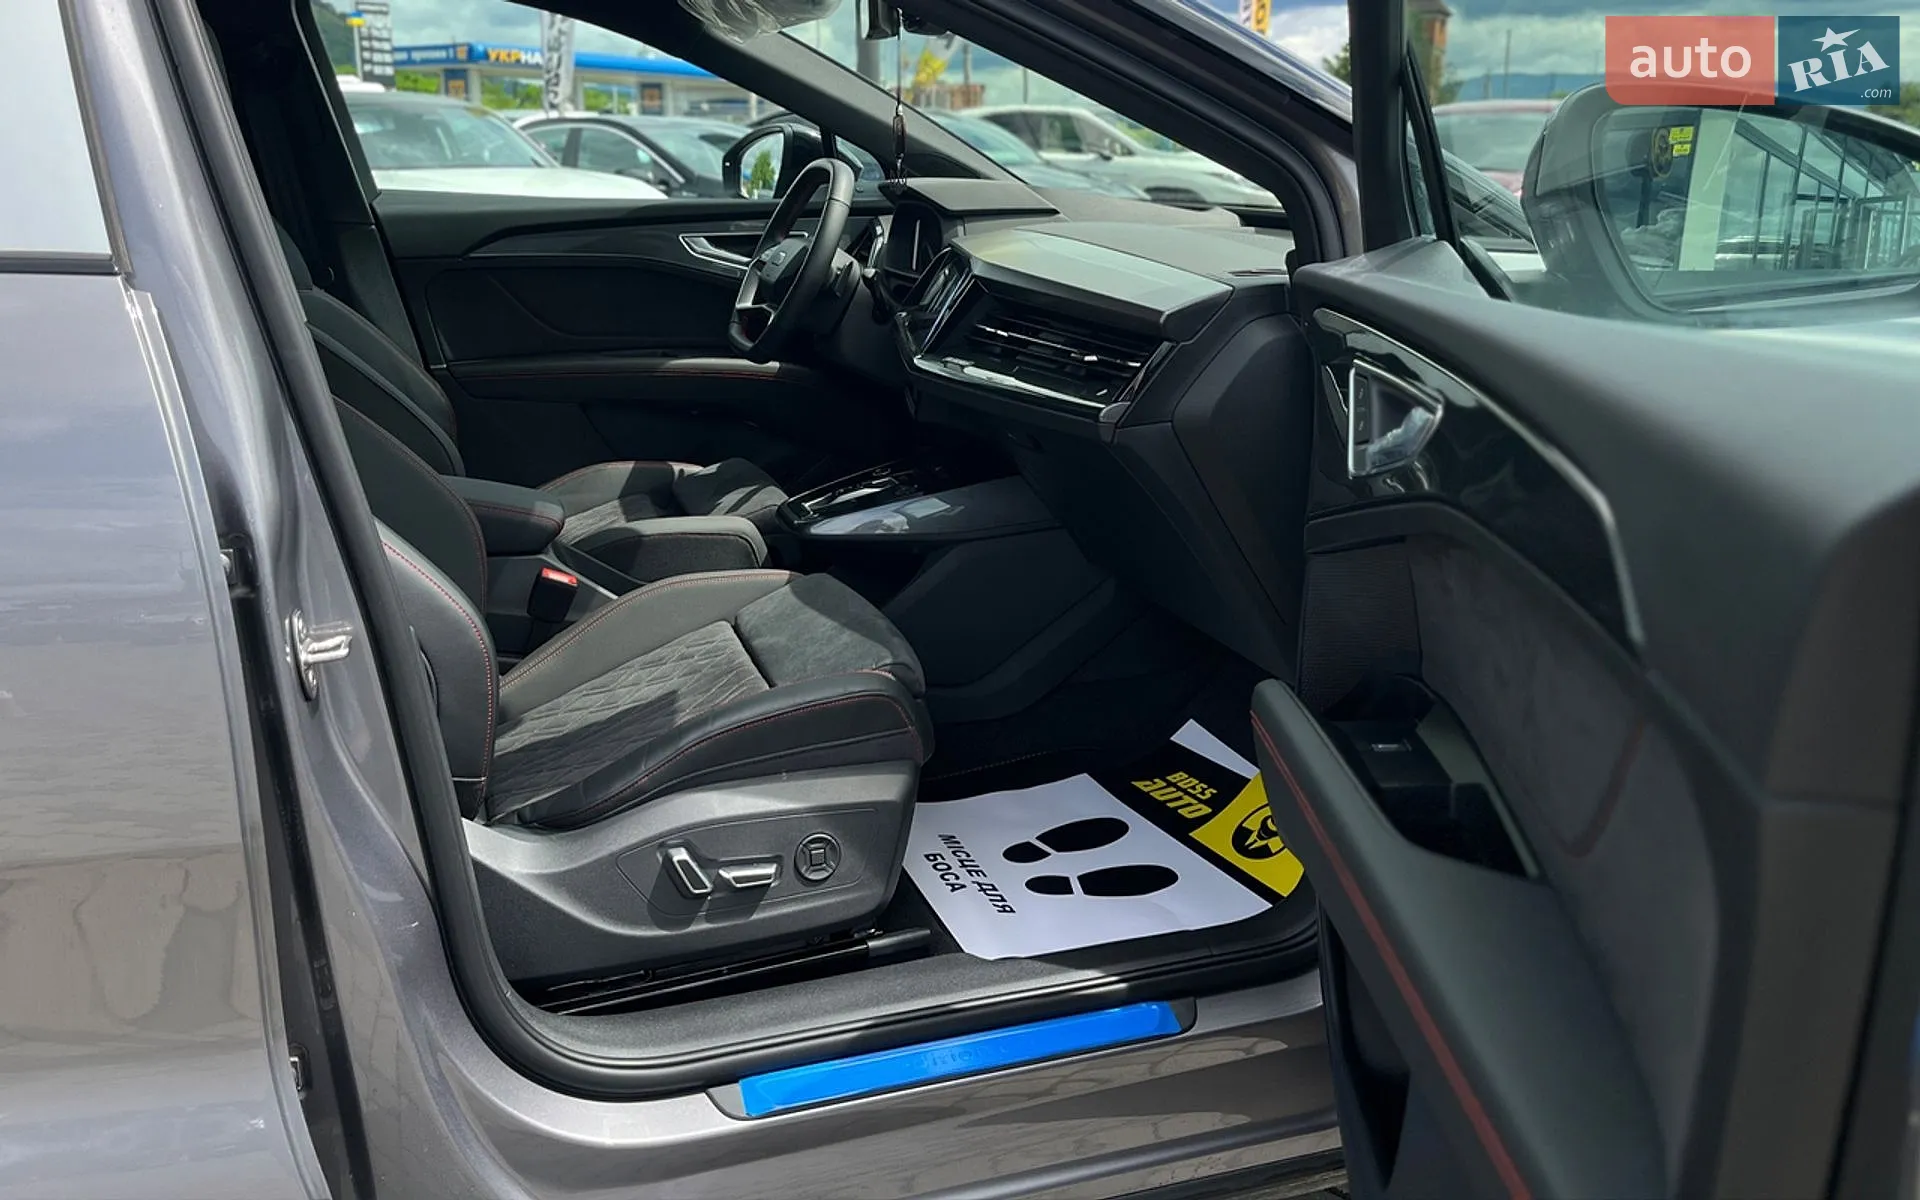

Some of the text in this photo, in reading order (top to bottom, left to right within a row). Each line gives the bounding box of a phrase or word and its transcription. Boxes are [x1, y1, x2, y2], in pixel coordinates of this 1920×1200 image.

[487, 46, 545, 65] УКРНА
[1131, 778, 1213, 819] AUTO
[1165, 770, 1218, 800] BOSS
[923, 853, 967, 893] БОСА
[938, 833, 1016, 914] МІСЦЕ ДЛЯ
